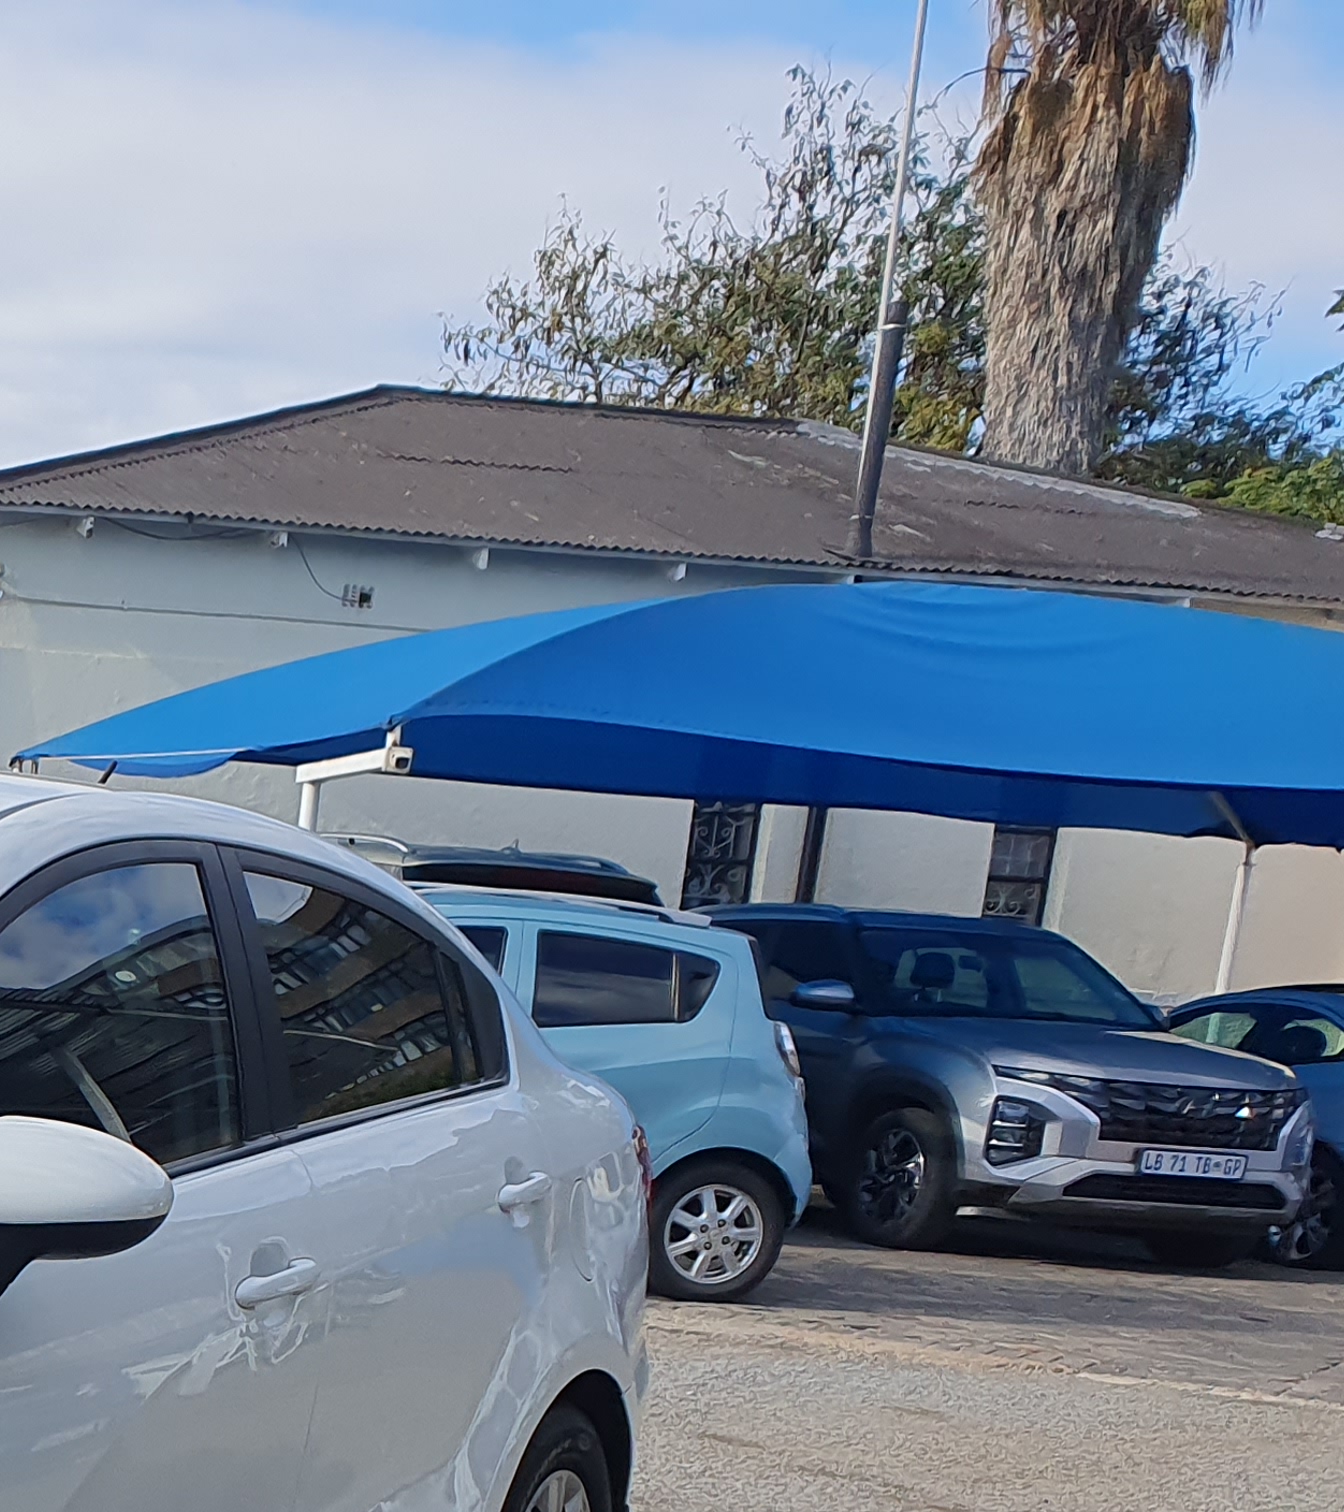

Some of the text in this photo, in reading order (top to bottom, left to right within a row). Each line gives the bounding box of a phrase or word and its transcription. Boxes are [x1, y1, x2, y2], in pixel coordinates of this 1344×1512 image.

[1144, 1152, 1242, 1175] LB 71 TB GP
